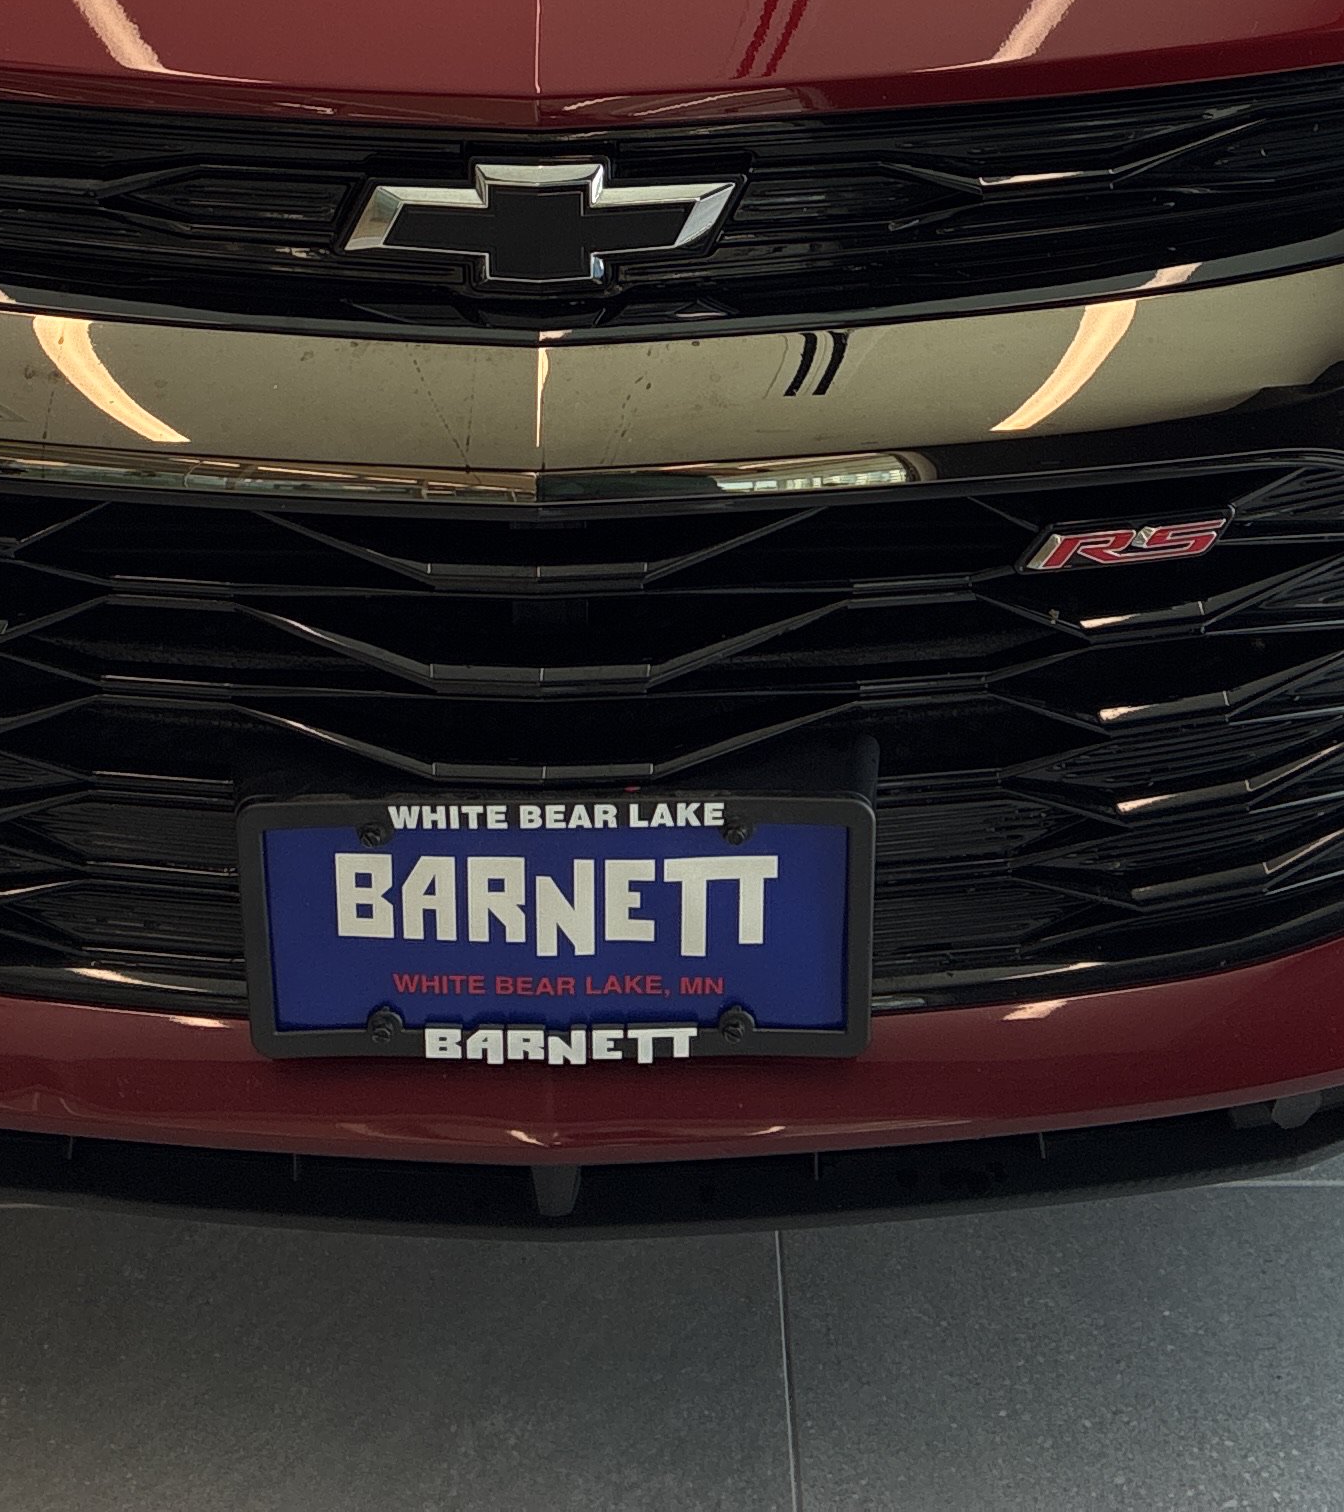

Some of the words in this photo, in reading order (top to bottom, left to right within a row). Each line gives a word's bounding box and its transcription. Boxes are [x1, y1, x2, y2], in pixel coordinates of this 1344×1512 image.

[1026, 518, 1227, 570] RS
[388, 804, 508, 830] WHITE
[520, 803, 617, 829] BEAR
[629, 801, 725, 828] LAKE
[334, 852, 779, 957] BARNETT
[392, 973, 486, 996] WHITE
[495, 974, 577, 996] BEAR
[586, 974, 670, 999] LAKE,
[679, 976, 725, 996] MN
[424, 1027, 698, 1065] BARNETT
